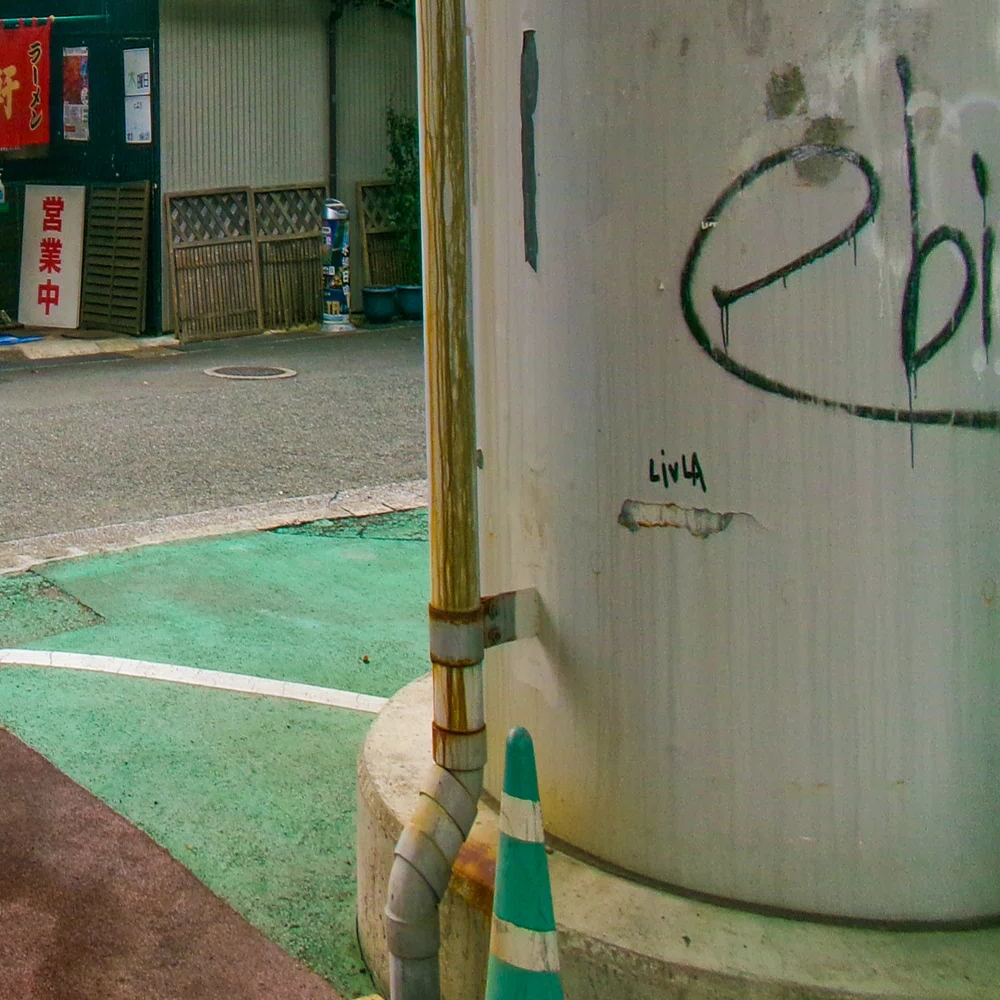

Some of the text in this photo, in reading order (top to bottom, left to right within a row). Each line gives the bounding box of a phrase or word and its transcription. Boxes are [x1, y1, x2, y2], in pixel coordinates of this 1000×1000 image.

[28, 41, 44, 131] ラーメン
[37, 195, 65, 316] 営業中
